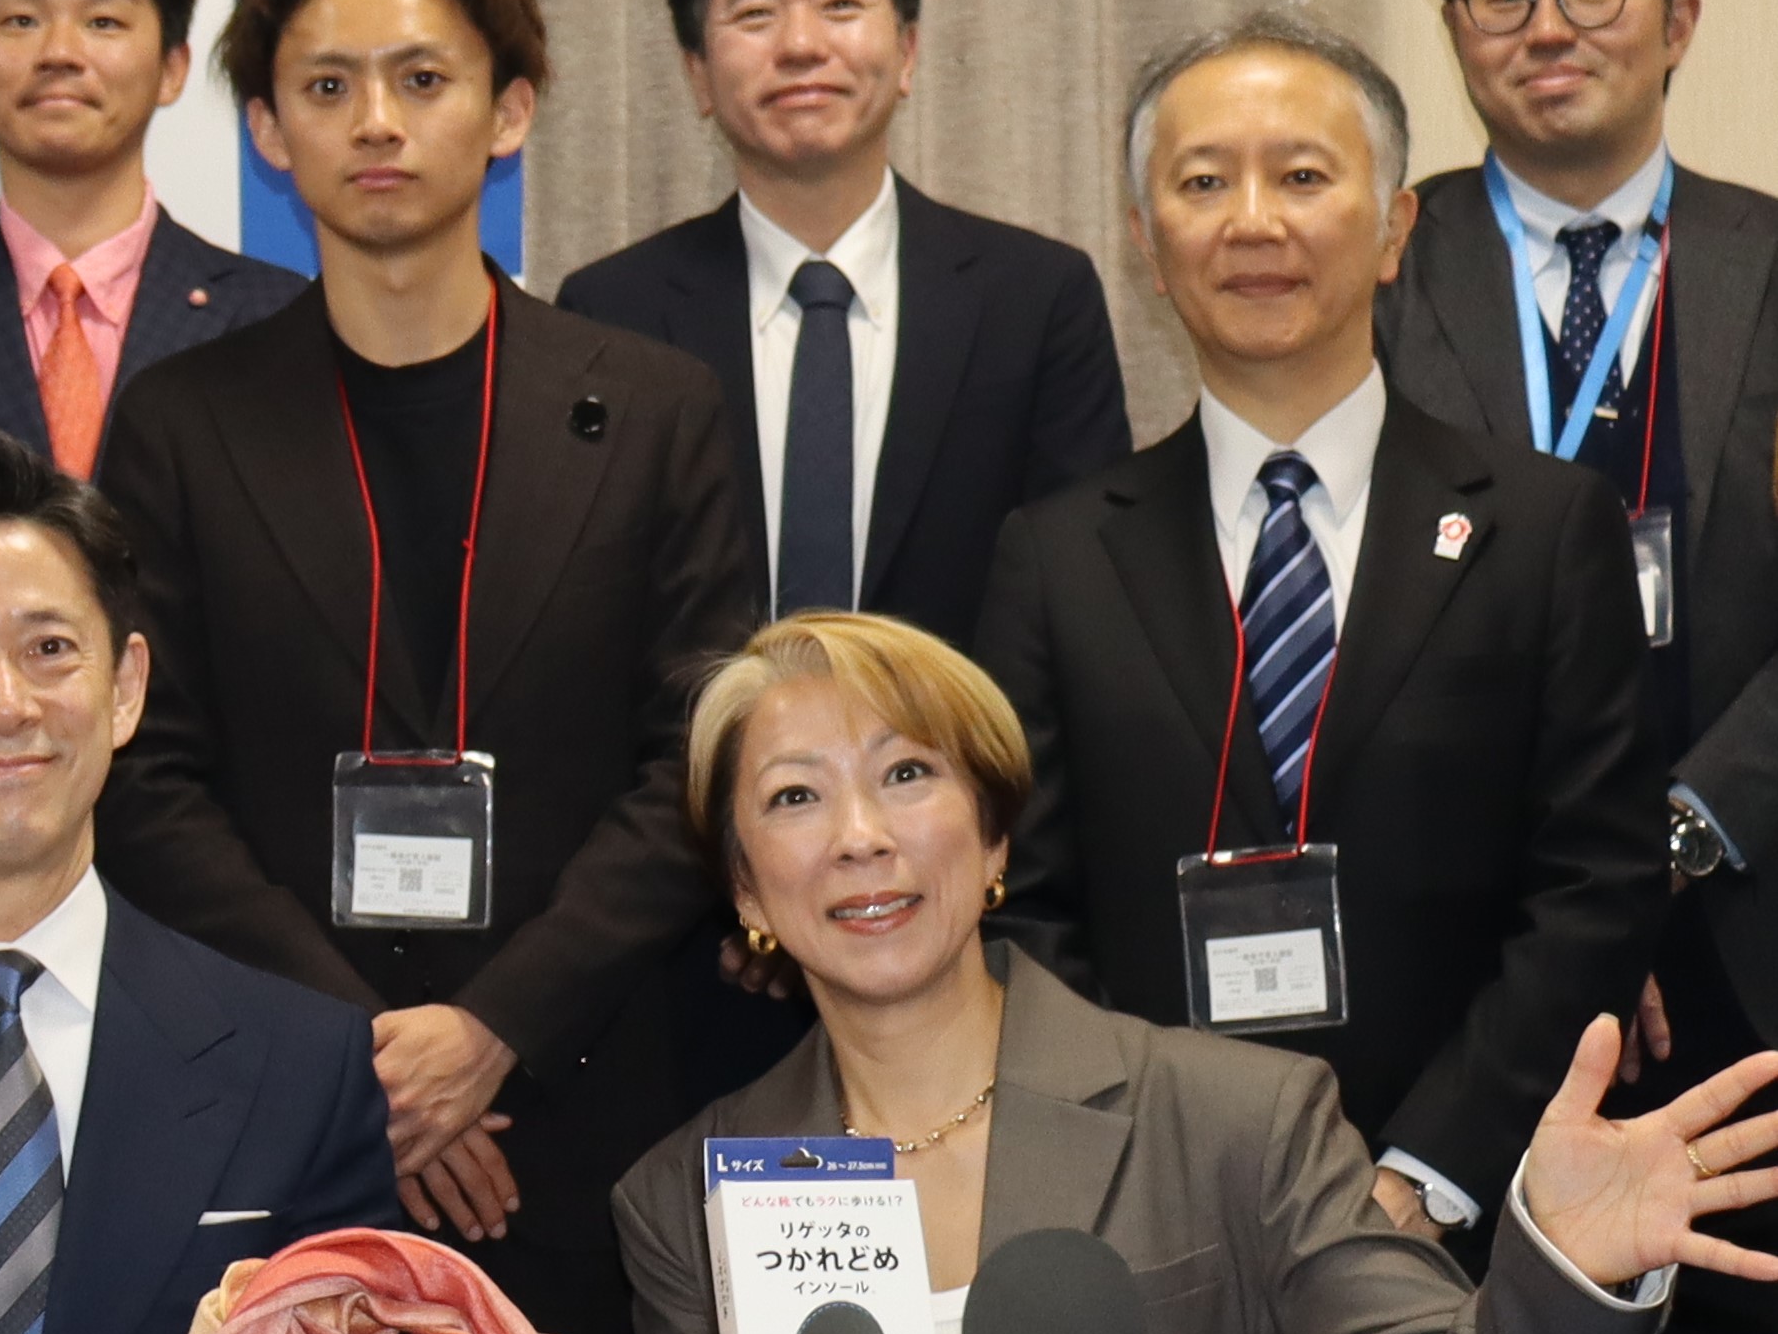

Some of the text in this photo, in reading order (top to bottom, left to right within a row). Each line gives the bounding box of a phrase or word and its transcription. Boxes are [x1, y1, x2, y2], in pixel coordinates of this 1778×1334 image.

[716, 1153, 728, 1172] L
[731, 1159, 764, 1172] サイズ
[780, 1222, 870, 1239] リゲッタの
[756, 1247, 900, 1272] つかれどめ
[794, 1281, 870, 1295] インソール
